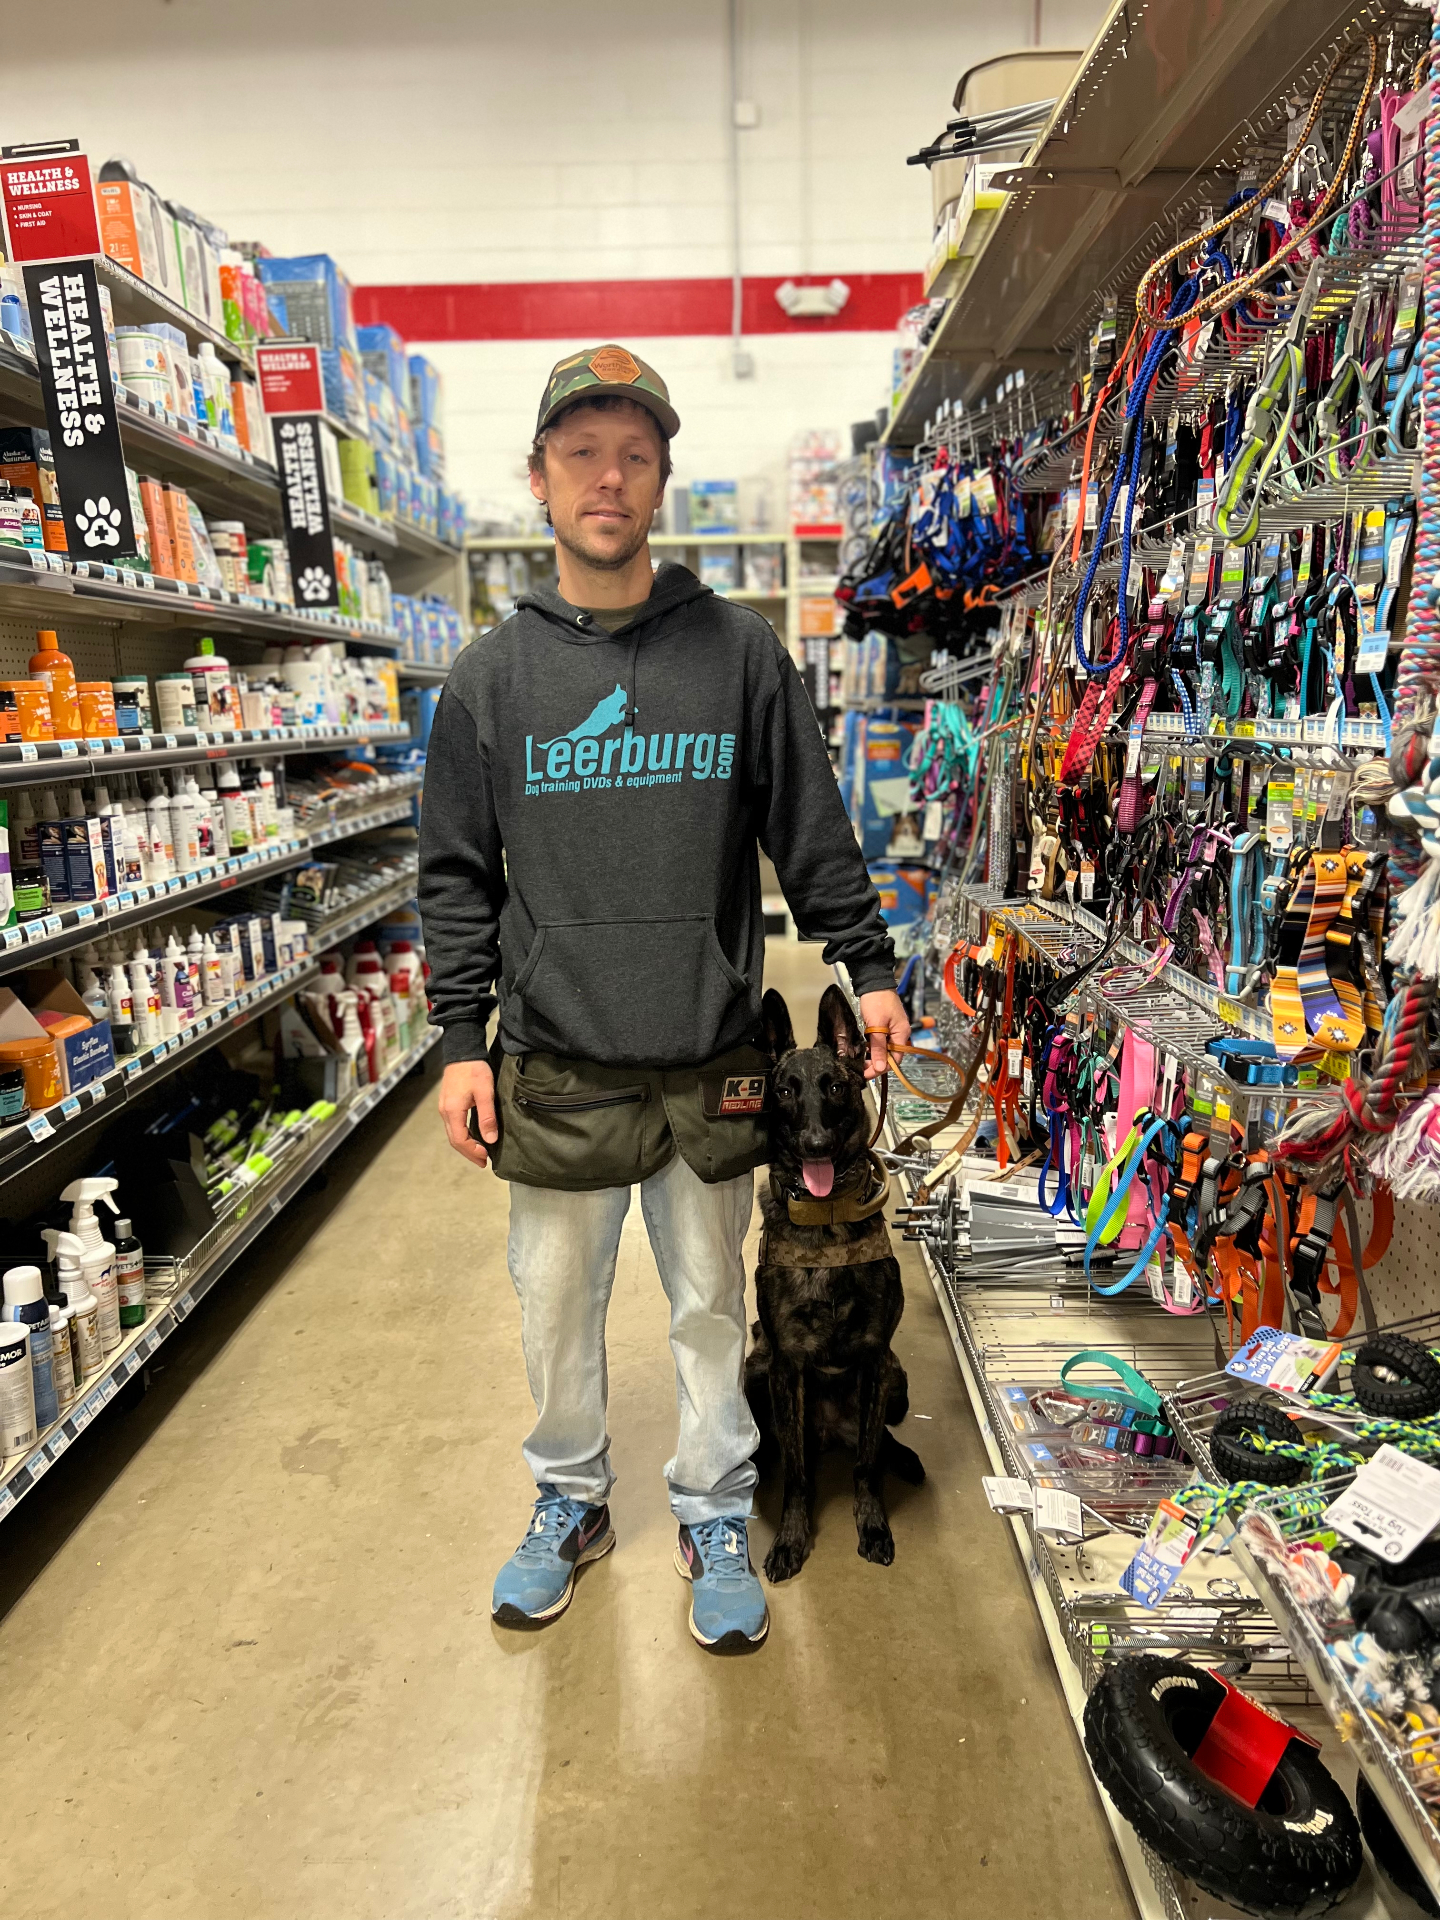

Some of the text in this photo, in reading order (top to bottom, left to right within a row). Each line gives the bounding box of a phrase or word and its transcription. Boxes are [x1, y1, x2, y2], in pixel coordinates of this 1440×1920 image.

[7, 166, 74, 184] HEALTH &
[8, 178, 80, 196] WELLNESS
[17, 203, 42, 211] NURSING
[37, 210, 53, 218] COAT
[39, 275, 85, 448] WELLNESS
[62, 273, 106, 435] HEALTH &
[260, 352, 299, 364] HEALTH
[261, 360, 312, 372] WELLNESS
[2, 454, 32, 462] Naturals
[279, 422, 308, 530] HEALTH &
[296, 421, 325, 537] WELLNESS
[525, 725, 717, 782] Leerburg
[525, 771, 683, 797] Dog training DVDs & equipment
[72, 1052, 90, 1066] Elastic
[90, 1043, 109, 1058] Bandage
[726, 1079, 764, 1098] K-9
[0, 1349, 23, 1361] MOR
[1250, 1364, 1272, 1378] Tug
[1271, 1334, 1292, 1353] Toss
[1352, 1500, 1374, 1517] Toss
[1387, 1519, 1407, 1537] Tug
[1158, 1564, 1172, 1585] Tug
